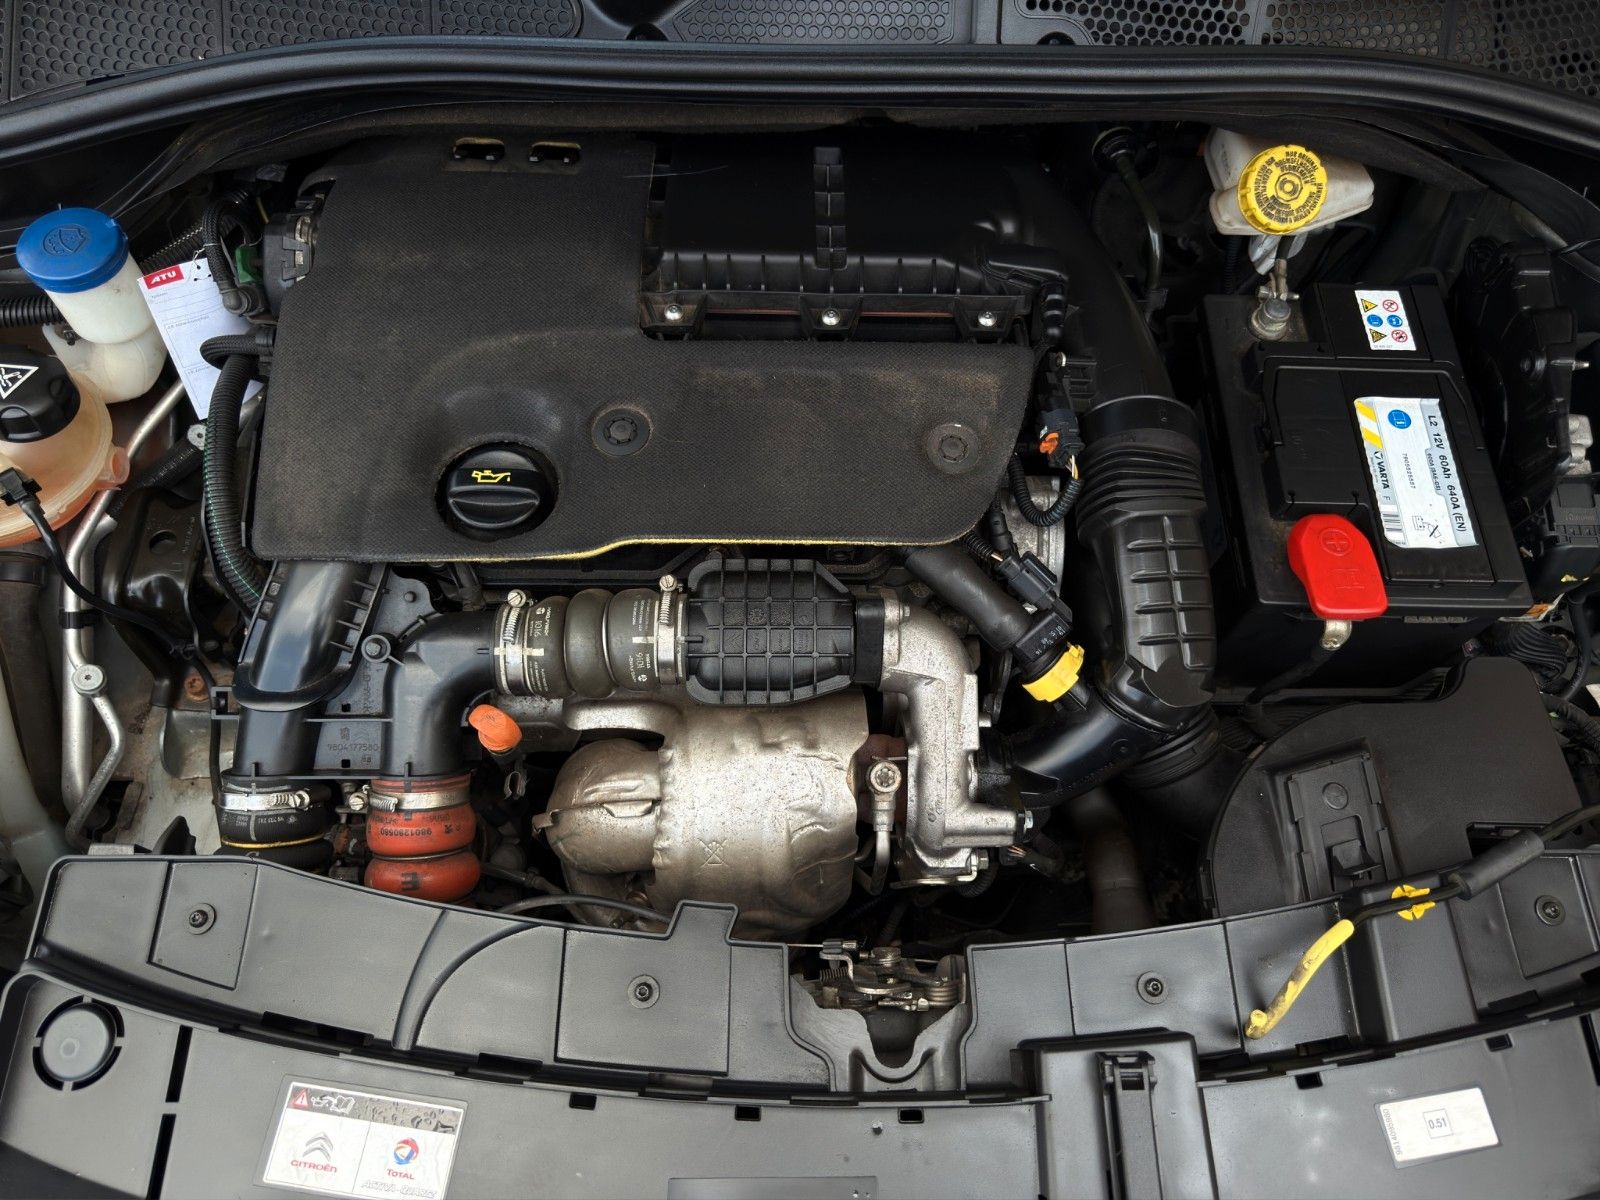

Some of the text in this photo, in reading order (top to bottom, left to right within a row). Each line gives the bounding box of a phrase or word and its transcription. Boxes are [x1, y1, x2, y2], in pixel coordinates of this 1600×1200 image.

[1298, 152, 1318, 172] ORIGINAL
[1308, 183, 1324, 210] CONTAINER
[150, 270, 176, 284] ATU
[1376, 462, 1390, 490] VARTA
[1428, 415, 1467, 532] L2 12V 60Ah 640A (EN)
[1428, 1118, 1447, 1129] 0.51
[386, 1168, 415, 1179] TOTAL
